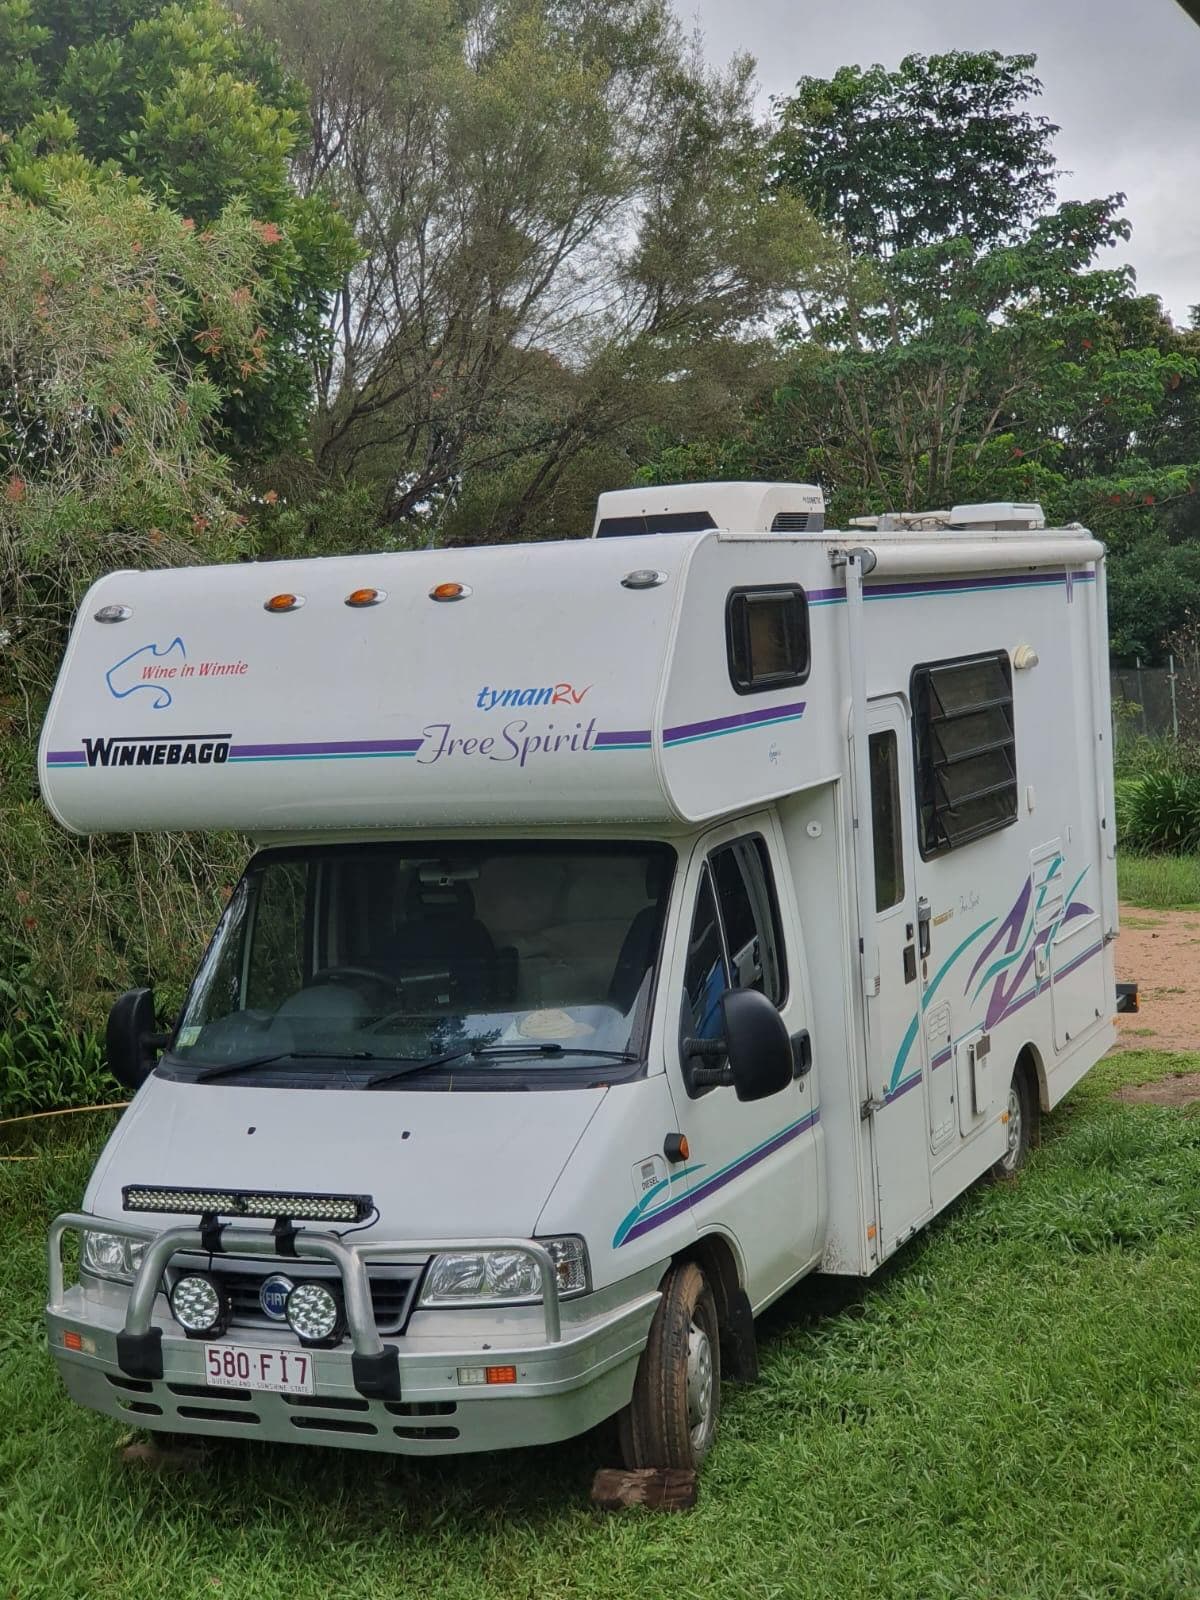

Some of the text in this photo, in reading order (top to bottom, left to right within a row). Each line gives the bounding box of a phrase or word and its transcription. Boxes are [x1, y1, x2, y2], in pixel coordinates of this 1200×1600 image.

[141, 660, 249, 680] Wine in Winnie
[82, 733, 232, 767] WINNEBAGO
[416, 717, 597, 768] Free Spirit
[265, 1292, 289, 1306] FIAT
[208, 1349, 250, 1380] 580
